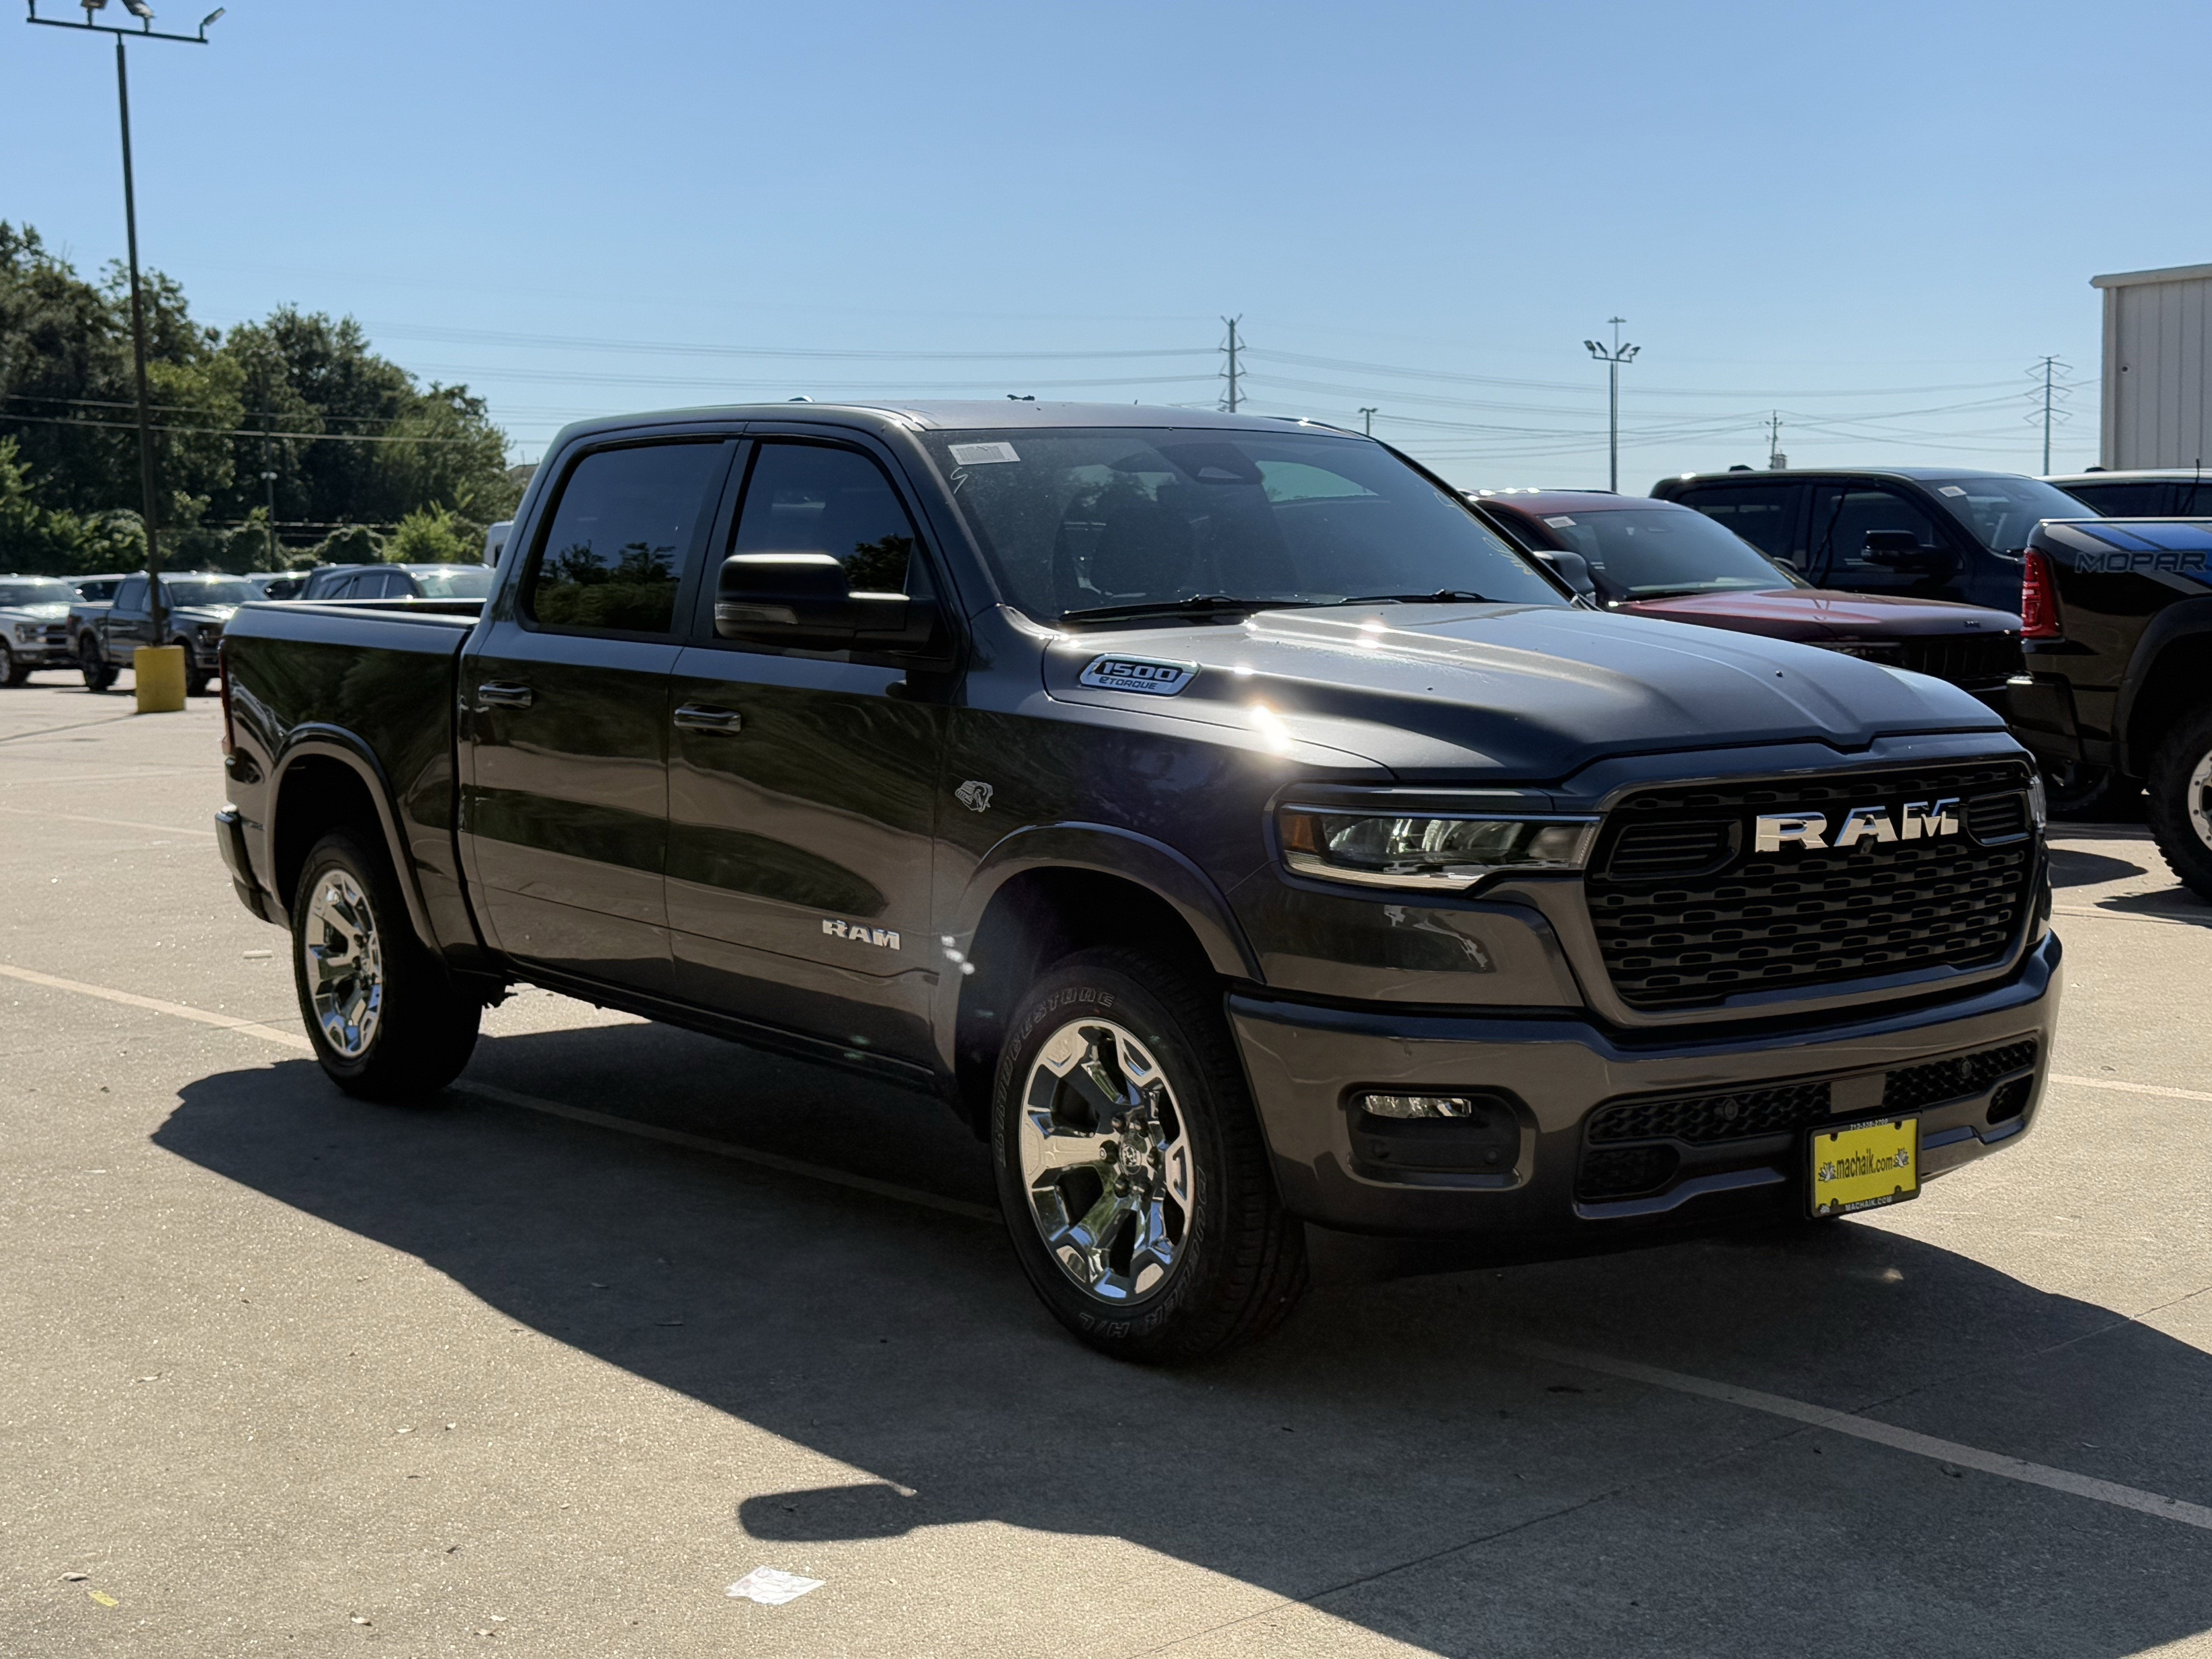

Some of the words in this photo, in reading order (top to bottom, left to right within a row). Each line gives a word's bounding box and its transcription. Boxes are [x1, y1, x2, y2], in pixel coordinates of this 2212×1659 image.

[2075, 551, 2207, 573] MOPAR
[1103, 661, 1180, 681] 1500
[1755, 797, 1960, 853] RAM
[823, 919, 901, 950] RAM
[1836, 1148, 1893, 1179] machaik.com
[1845, 1195, 1893, 1211] MACHAIK.COM
